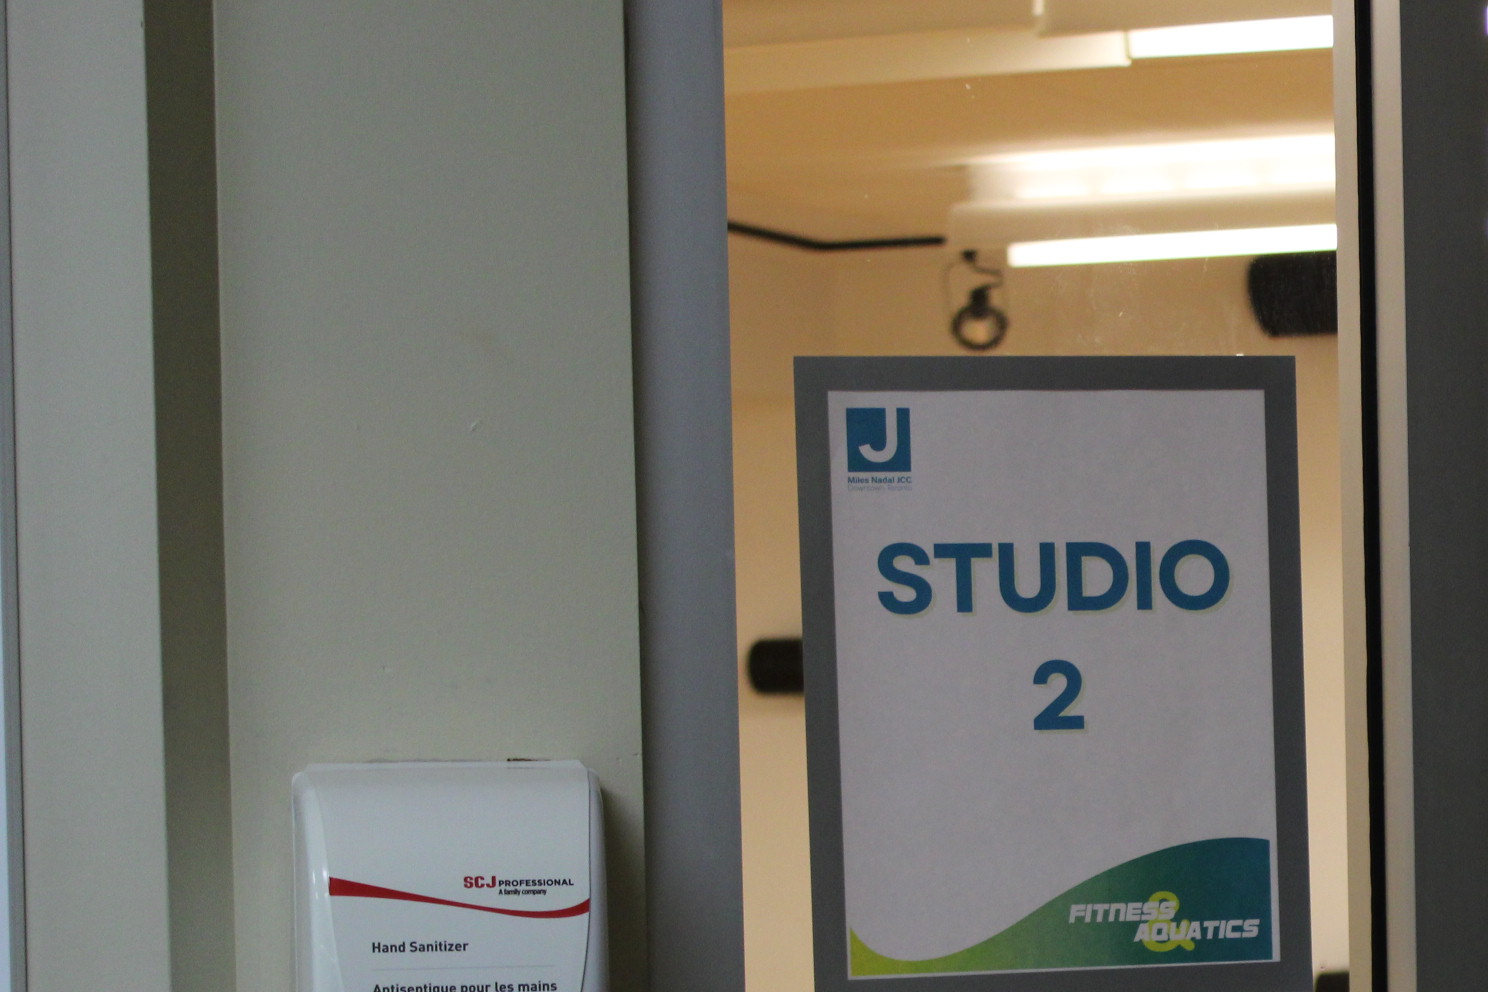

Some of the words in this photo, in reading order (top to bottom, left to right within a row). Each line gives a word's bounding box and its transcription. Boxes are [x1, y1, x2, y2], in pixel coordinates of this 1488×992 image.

[858, 408, 898, 463] J
[847, 476, 870, 484] Miles
[871, 476, 895, 484] Nadal
[897, 476, 913, 484] JCC
[877, 539, 1231, 616] STUDIO
[1032, 659, 1086, 732] 2
[463, 875, 497, 889] SCJ
[498, 878, 575, 888] PROFESSIONAL
[504, 888, 521, 896] family
[1068, 901, 1178, 924] FITNESS
[1133, 918, 1261, 943] AQUATICS
[371, 941, 406, 953] Hand
[409, 940, 469, 953] Sanitizer
[494, 981, 514, 992] les
[517, 980, 558, 992] mains
